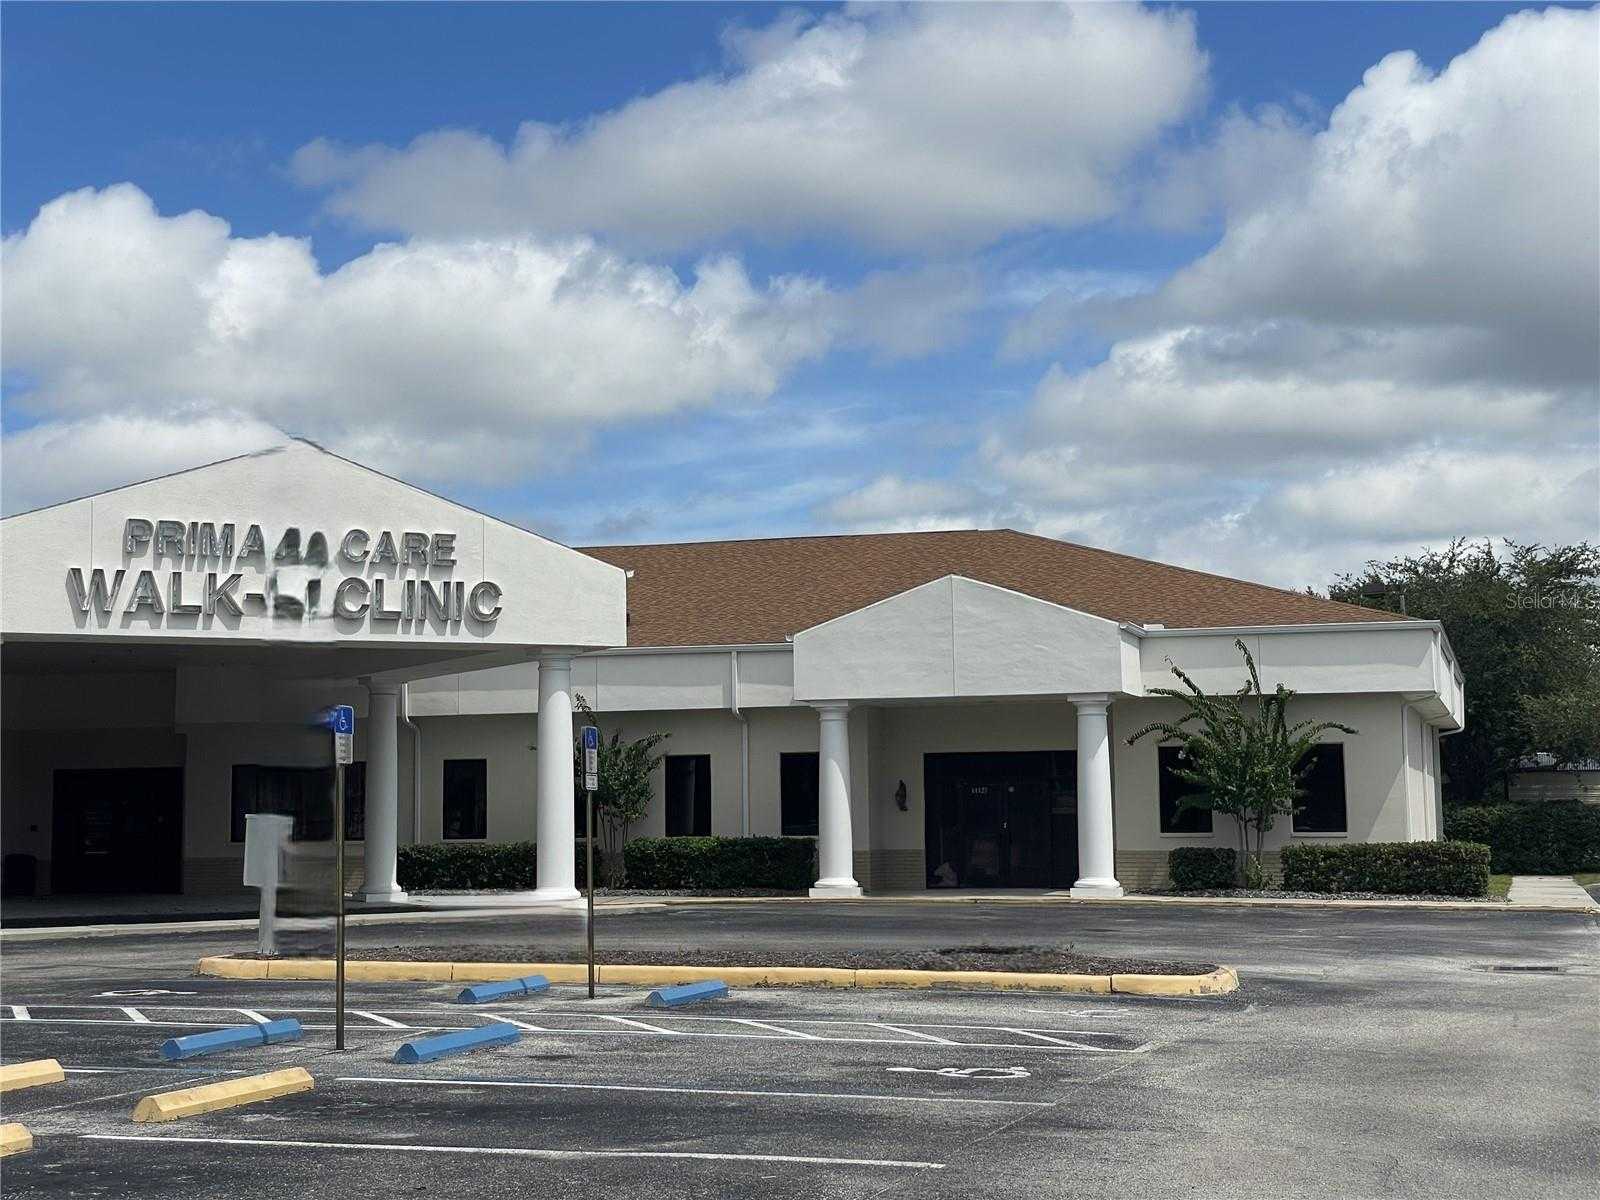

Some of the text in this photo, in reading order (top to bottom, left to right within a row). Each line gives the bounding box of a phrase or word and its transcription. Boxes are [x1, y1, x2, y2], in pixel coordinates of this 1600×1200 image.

[122, 518, 457, 567] PRIMA CARE
[334, 576, 503, 622] CLINIC
